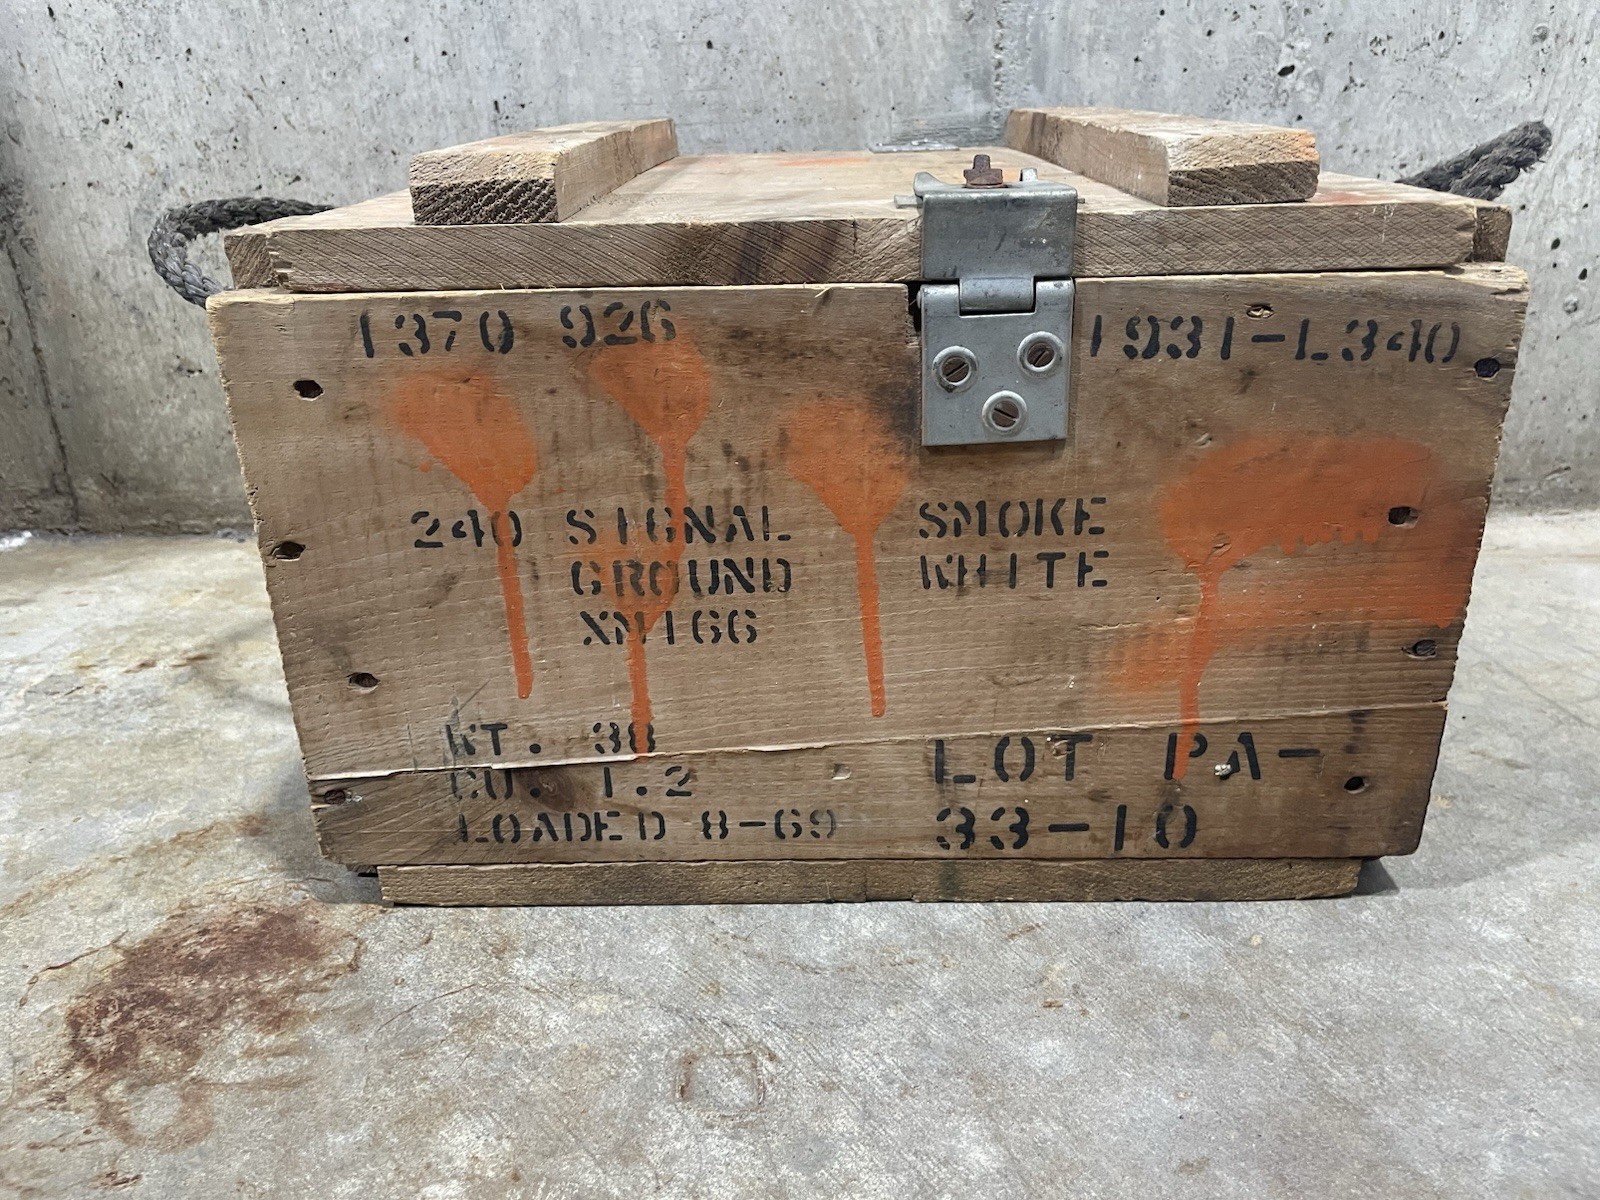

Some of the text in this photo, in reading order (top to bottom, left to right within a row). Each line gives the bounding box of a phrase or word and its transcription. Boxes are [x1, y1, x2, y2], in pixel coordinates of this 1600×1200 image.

[360, 300, 1461, 364] 1370 926 1931-L340
[411, 505, 792, 549] 240 SIGNAL
[919, 497, 1107, 539] SMOKE
[571, 557, 792, 597] GROUND
[920, 551, 1110, 590] WHITE
[580, 610, 758, 646] XM166
[446, 722, 656, 756] WT. 38
[935, 732, 1321, 784] LOT PA-
[450, 766, 693, 800] CU. 1.2
[458, 809, 837, 844] LOADED 8-69
[936, 804, 1198, 852] 33-10
